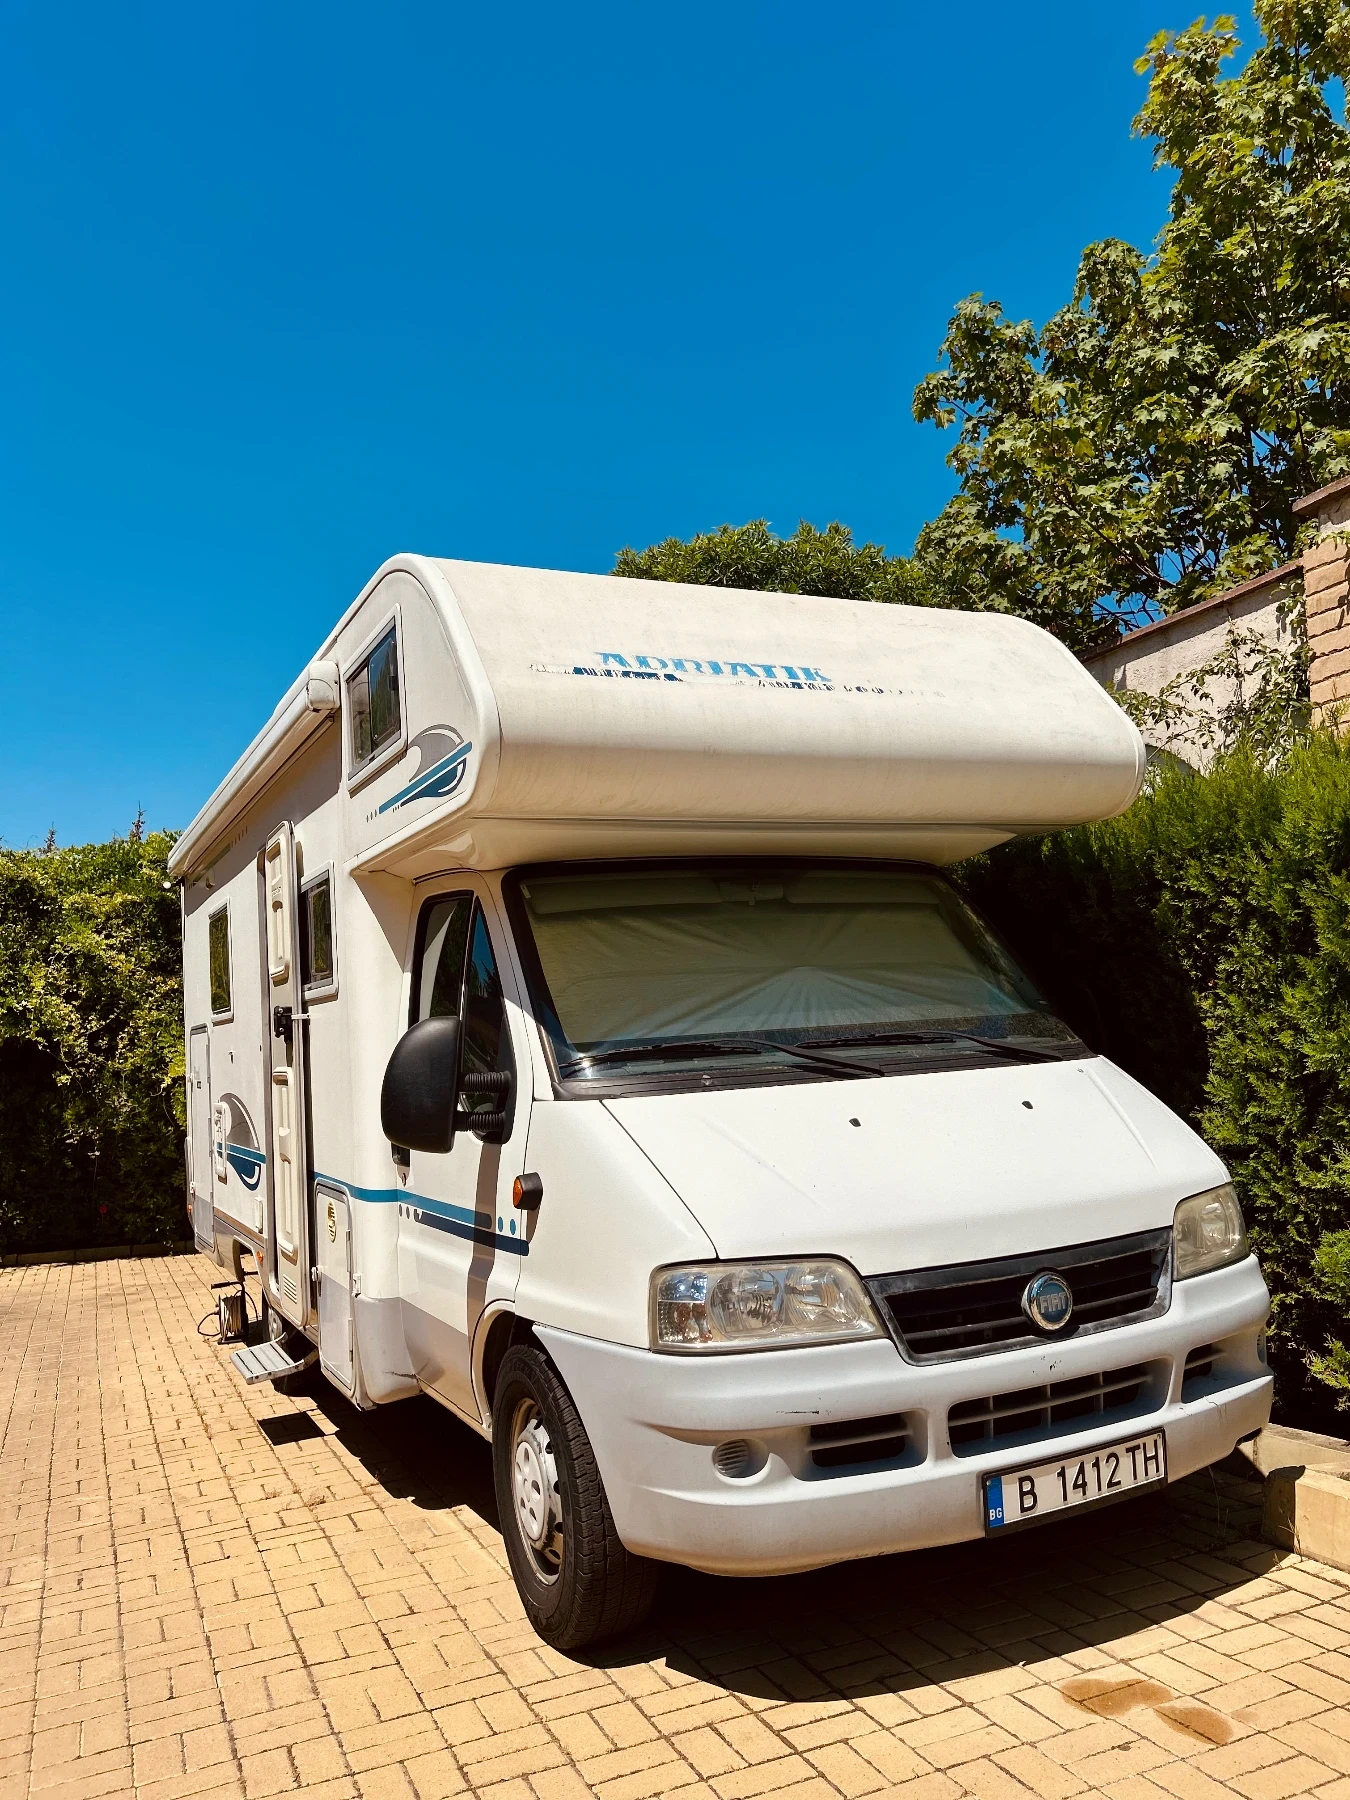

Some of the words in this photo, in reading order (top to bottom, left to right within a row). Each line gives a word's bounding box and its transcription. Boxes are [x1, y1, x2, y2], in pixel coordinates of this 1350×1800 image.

[593, 652, 831, 682] ADRIATIK
[1040, 1292, 1066, 1313] FIAT
[1018, 1475, 1037, 1513] B
[1057, 1453, 1121, 1501] 1412
[1126, 1439, 1160, 1480] TH
[989, 1508, 1003, 1521] BG
